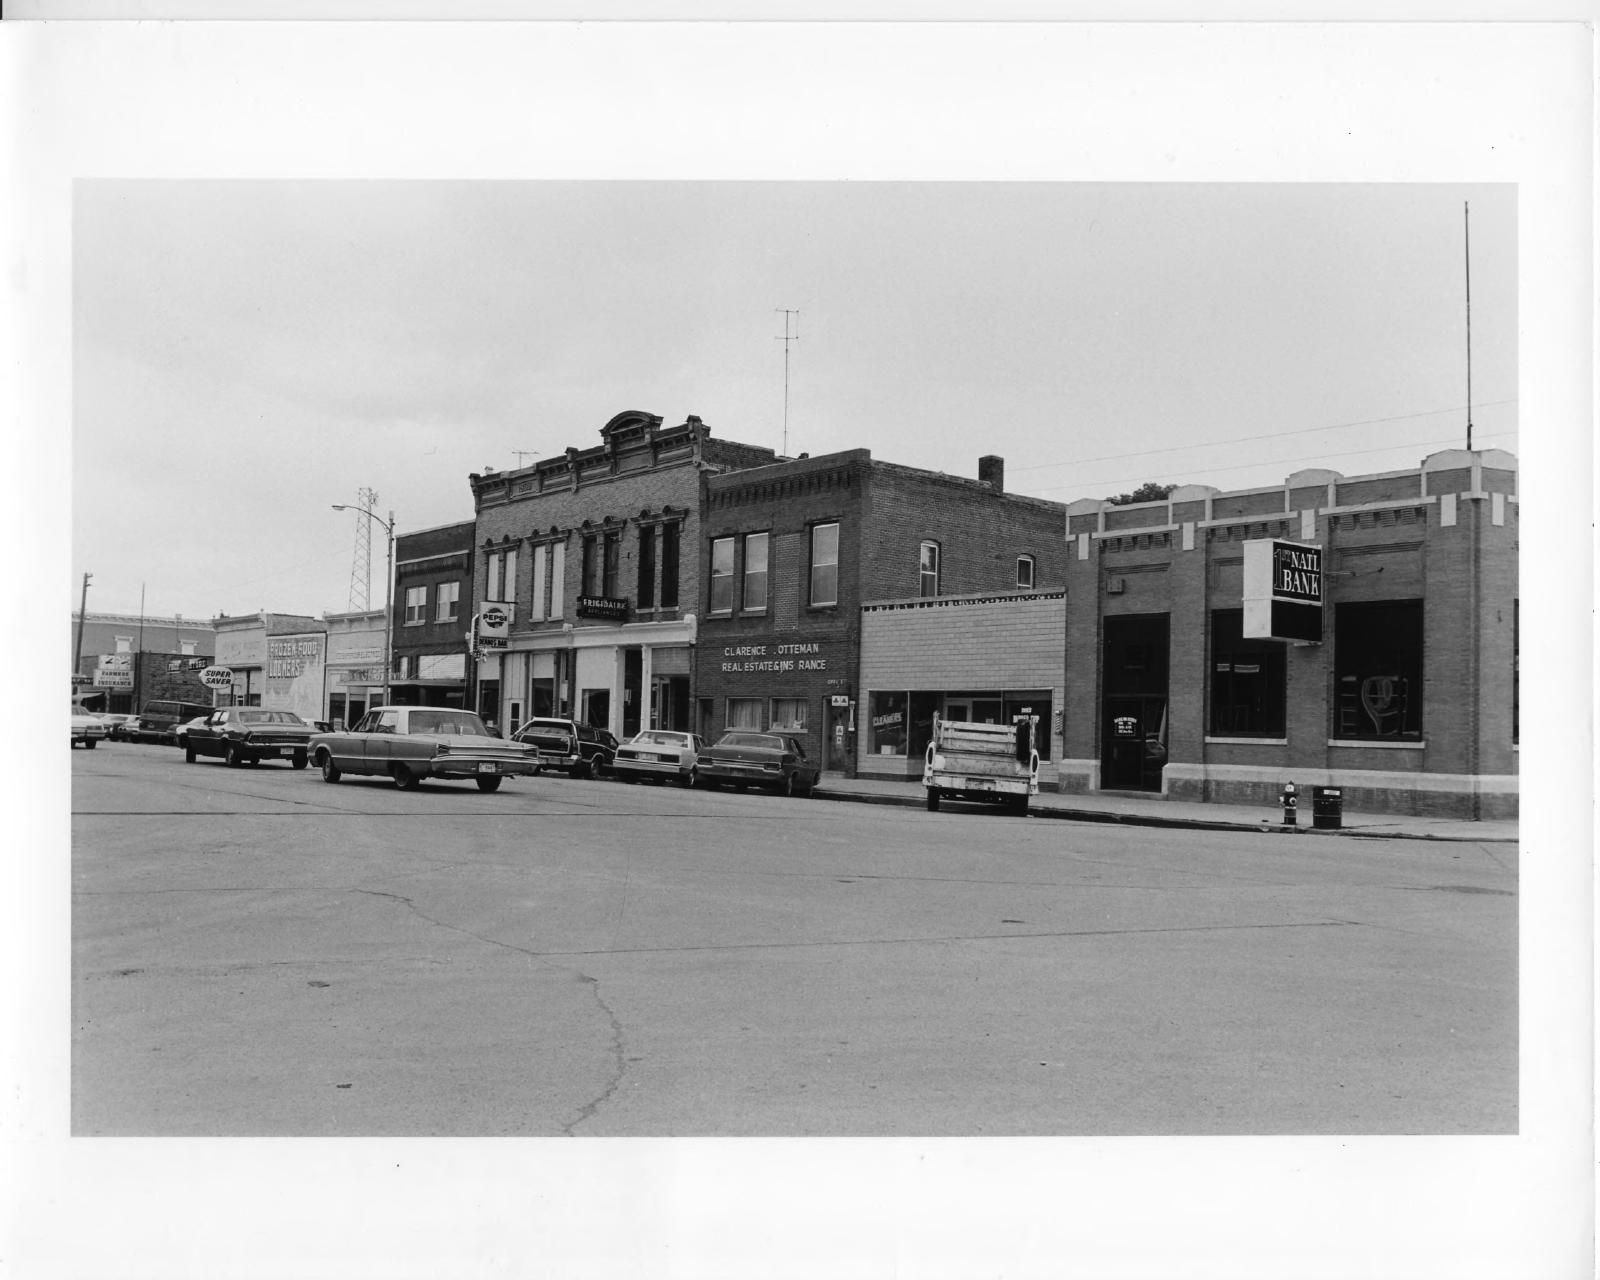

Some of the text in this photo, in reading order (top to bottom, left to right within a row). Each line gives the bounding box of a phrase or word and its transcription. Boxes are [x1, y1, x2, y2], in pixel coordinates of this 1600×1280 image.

[1282, 568, 1320, 596] BANK
[583, 598, 627, 609] FRIGIDAIRE
[482, 613, 508, 622] PEPSI
[724, 645, 767, 656] CLARENCE
[721, 662, 743, 672] REAL
[205, 670, 231, 678] SUPER
[205, 677, 232, 685] SAVER
[872, 712, 904, 727] CLEANERS
